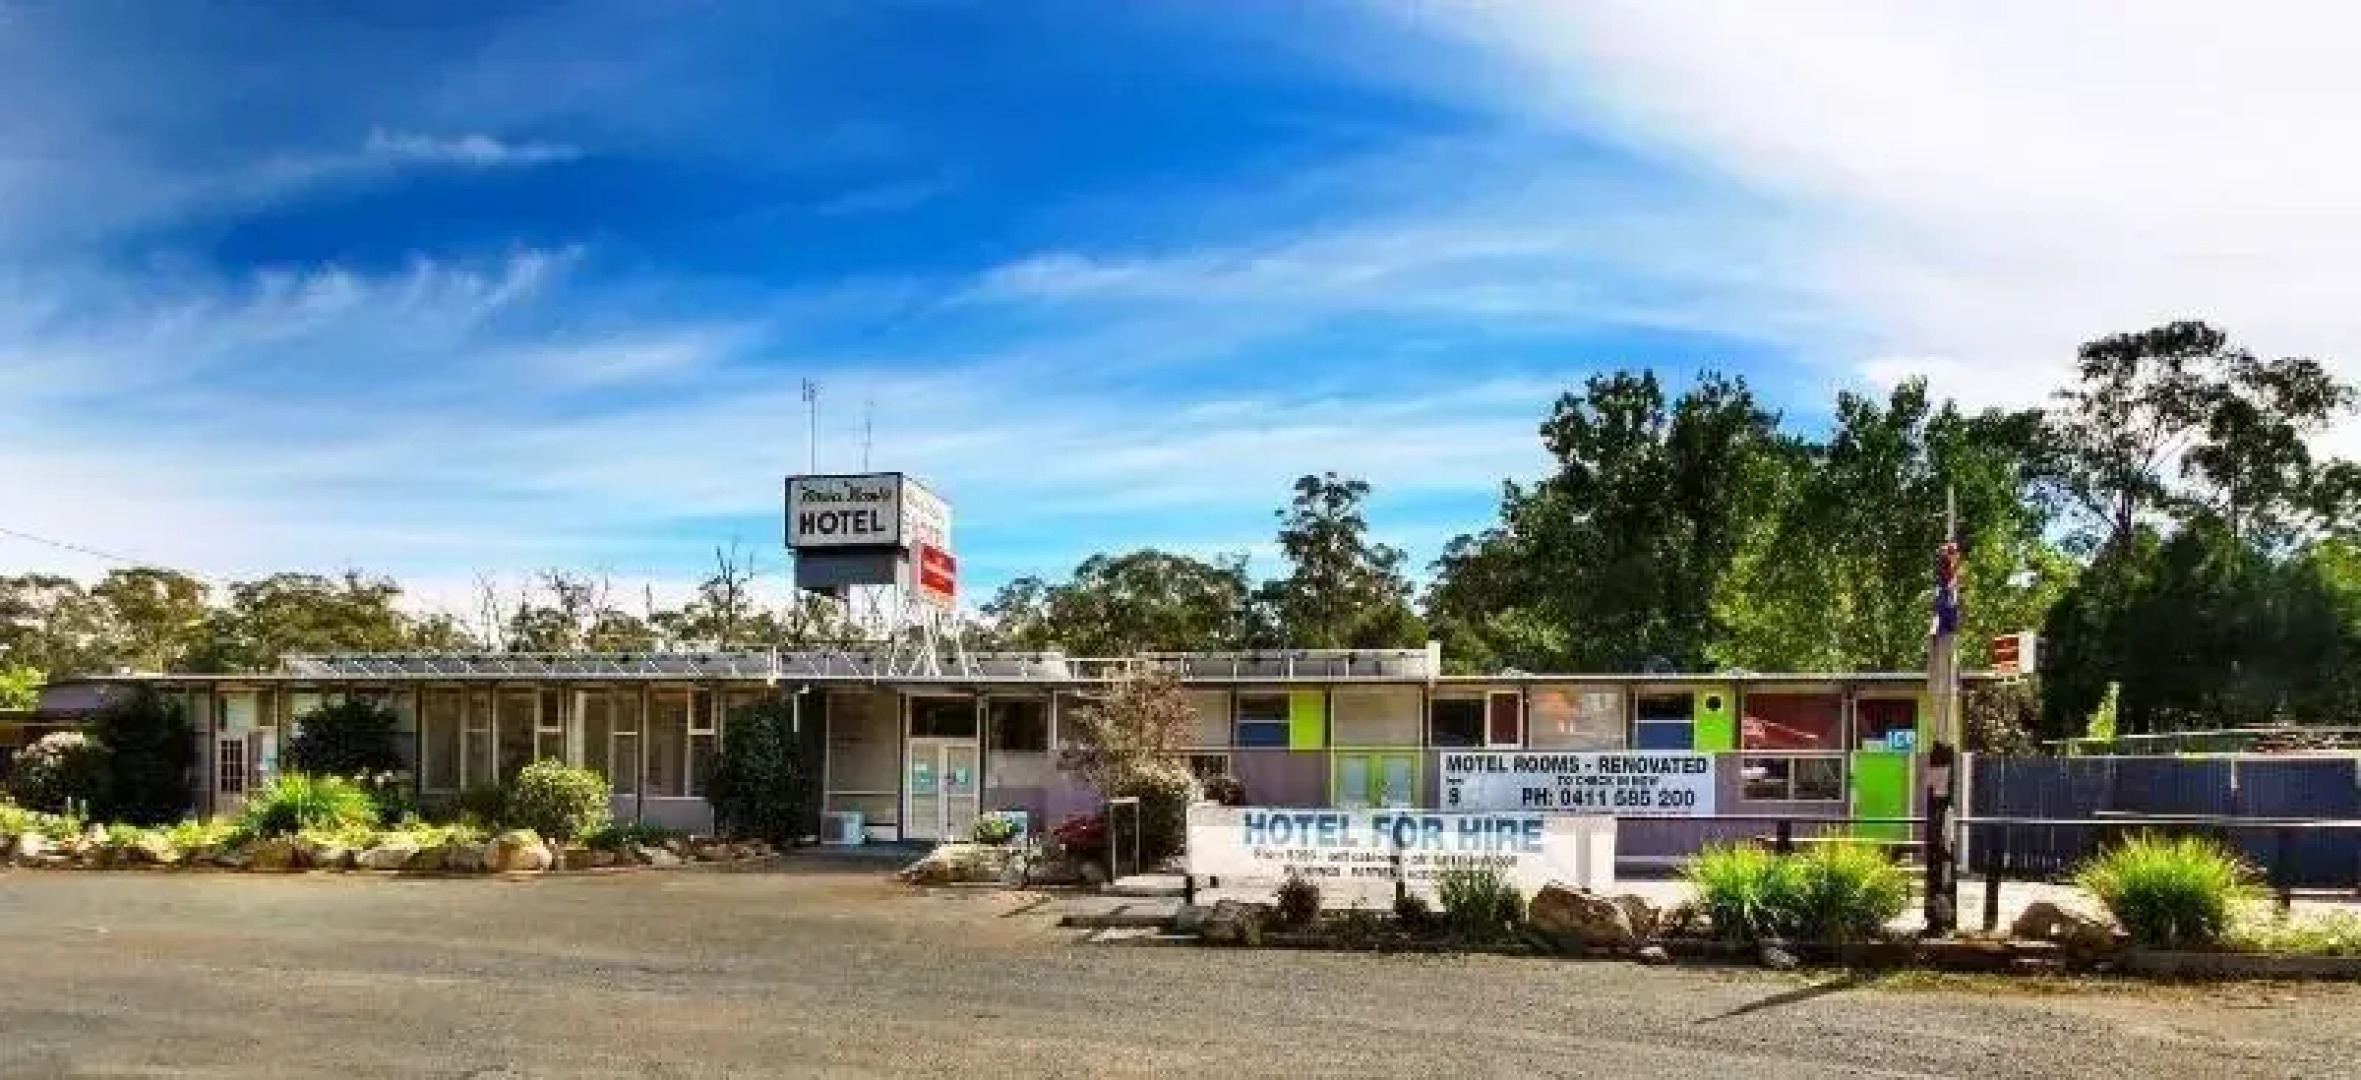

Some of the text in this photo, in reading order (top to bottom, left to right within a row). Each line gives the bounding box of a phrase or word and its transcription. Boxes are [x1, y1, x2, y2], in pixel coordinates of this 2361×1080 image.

[799, 509, 886, 535] HOTEL
[1446, 755, 1508, 773] MOTEL
[1514, 755, 1580, 773] ROOMS
[1599, 756, 1707, 774] RENOVATED
[1522, 787, 1553, 806] PH:
[1560, 788, 1606, 806] 0411
[1658, 788, 1695, 807] 200
[1245, 813, 1544, 853] HOTEL FOR HIRE
